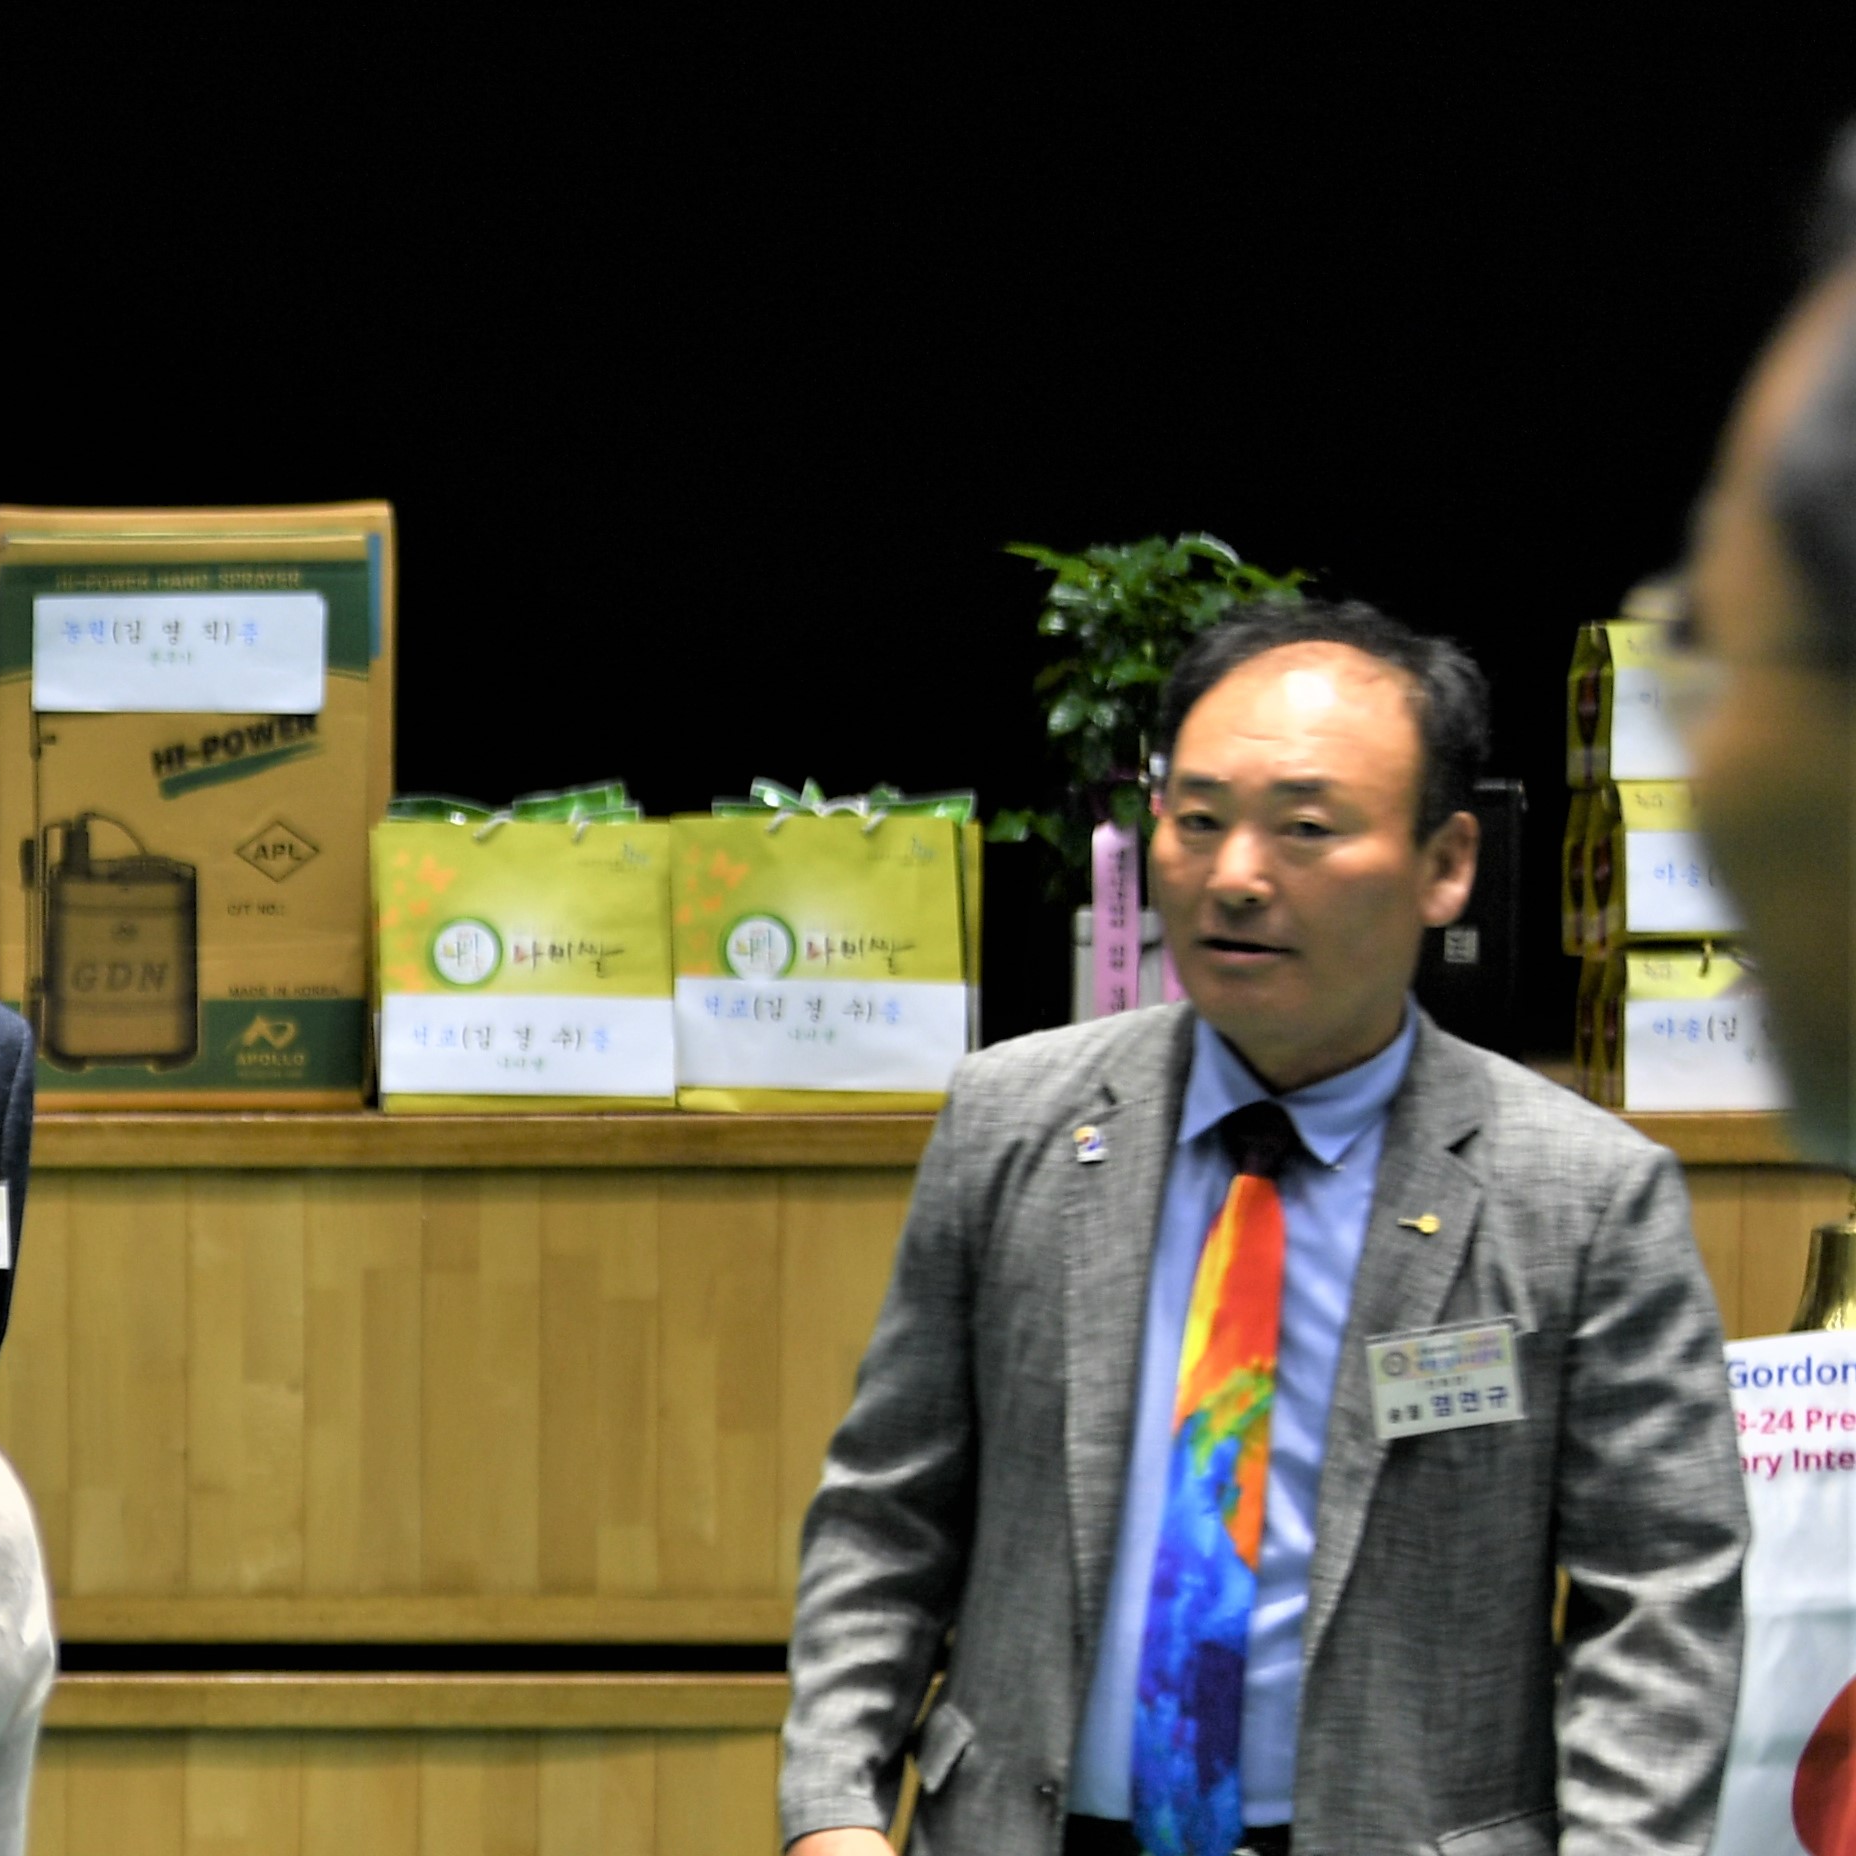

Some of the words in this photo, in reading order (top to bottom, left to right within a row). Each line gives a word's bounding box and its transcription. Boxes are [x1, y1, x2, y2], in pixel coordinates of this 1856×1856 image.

[251, 842, 306, 864] APL
[71, 960, 170, 994] GDN
[1726, 1355, 1856, 1389] Gordon
[1806, 1408, 1856, 1432] Pre
[1793, 1447, 1856, 1472] Inte
